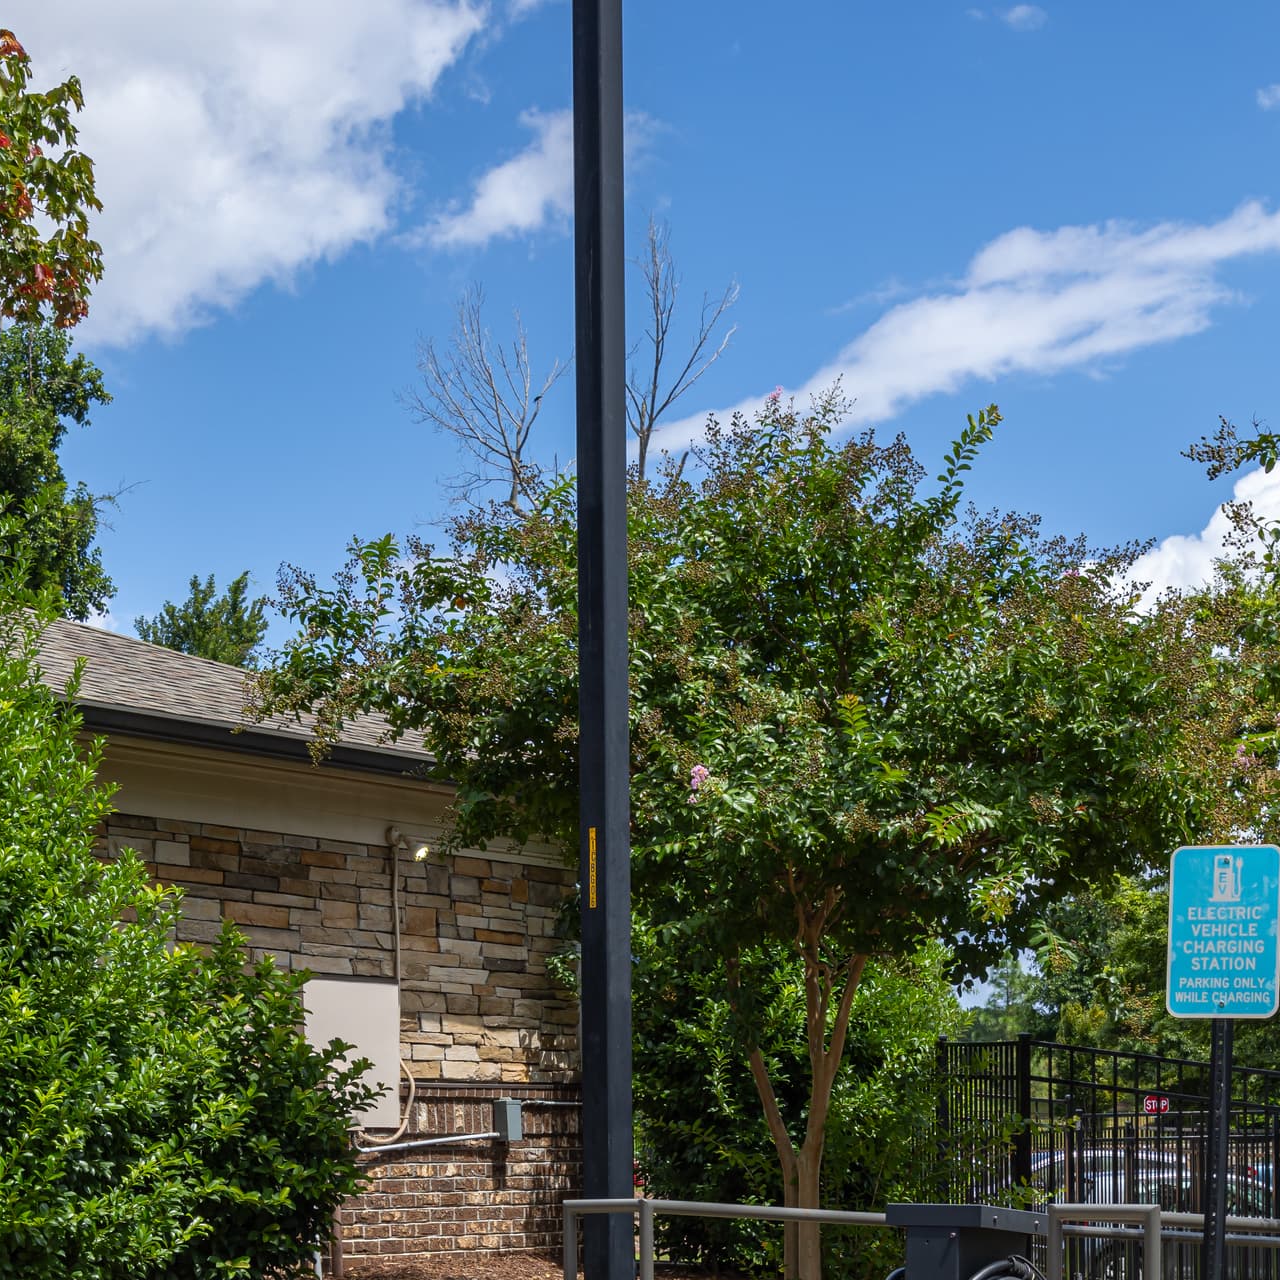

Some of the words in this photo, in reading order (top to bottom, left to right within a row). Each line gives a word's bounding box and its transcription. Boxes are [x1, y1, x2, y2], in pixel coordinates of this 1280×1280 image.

[1188, 906, 1261, 920] ELECTRIC
[1192, 924, 1258, 937] VEHICLE
[1183, 941, 1265, 954] CHARGING
[1191, 957, 1256, 970] STATION
[1179, 978, 1229, 989] PARKING
[1233, 977, 1265, 988] ONLY
[1175, 992, 1208, 1003] WHILE
[1212, 991, 1270, 1003] CHARGING
